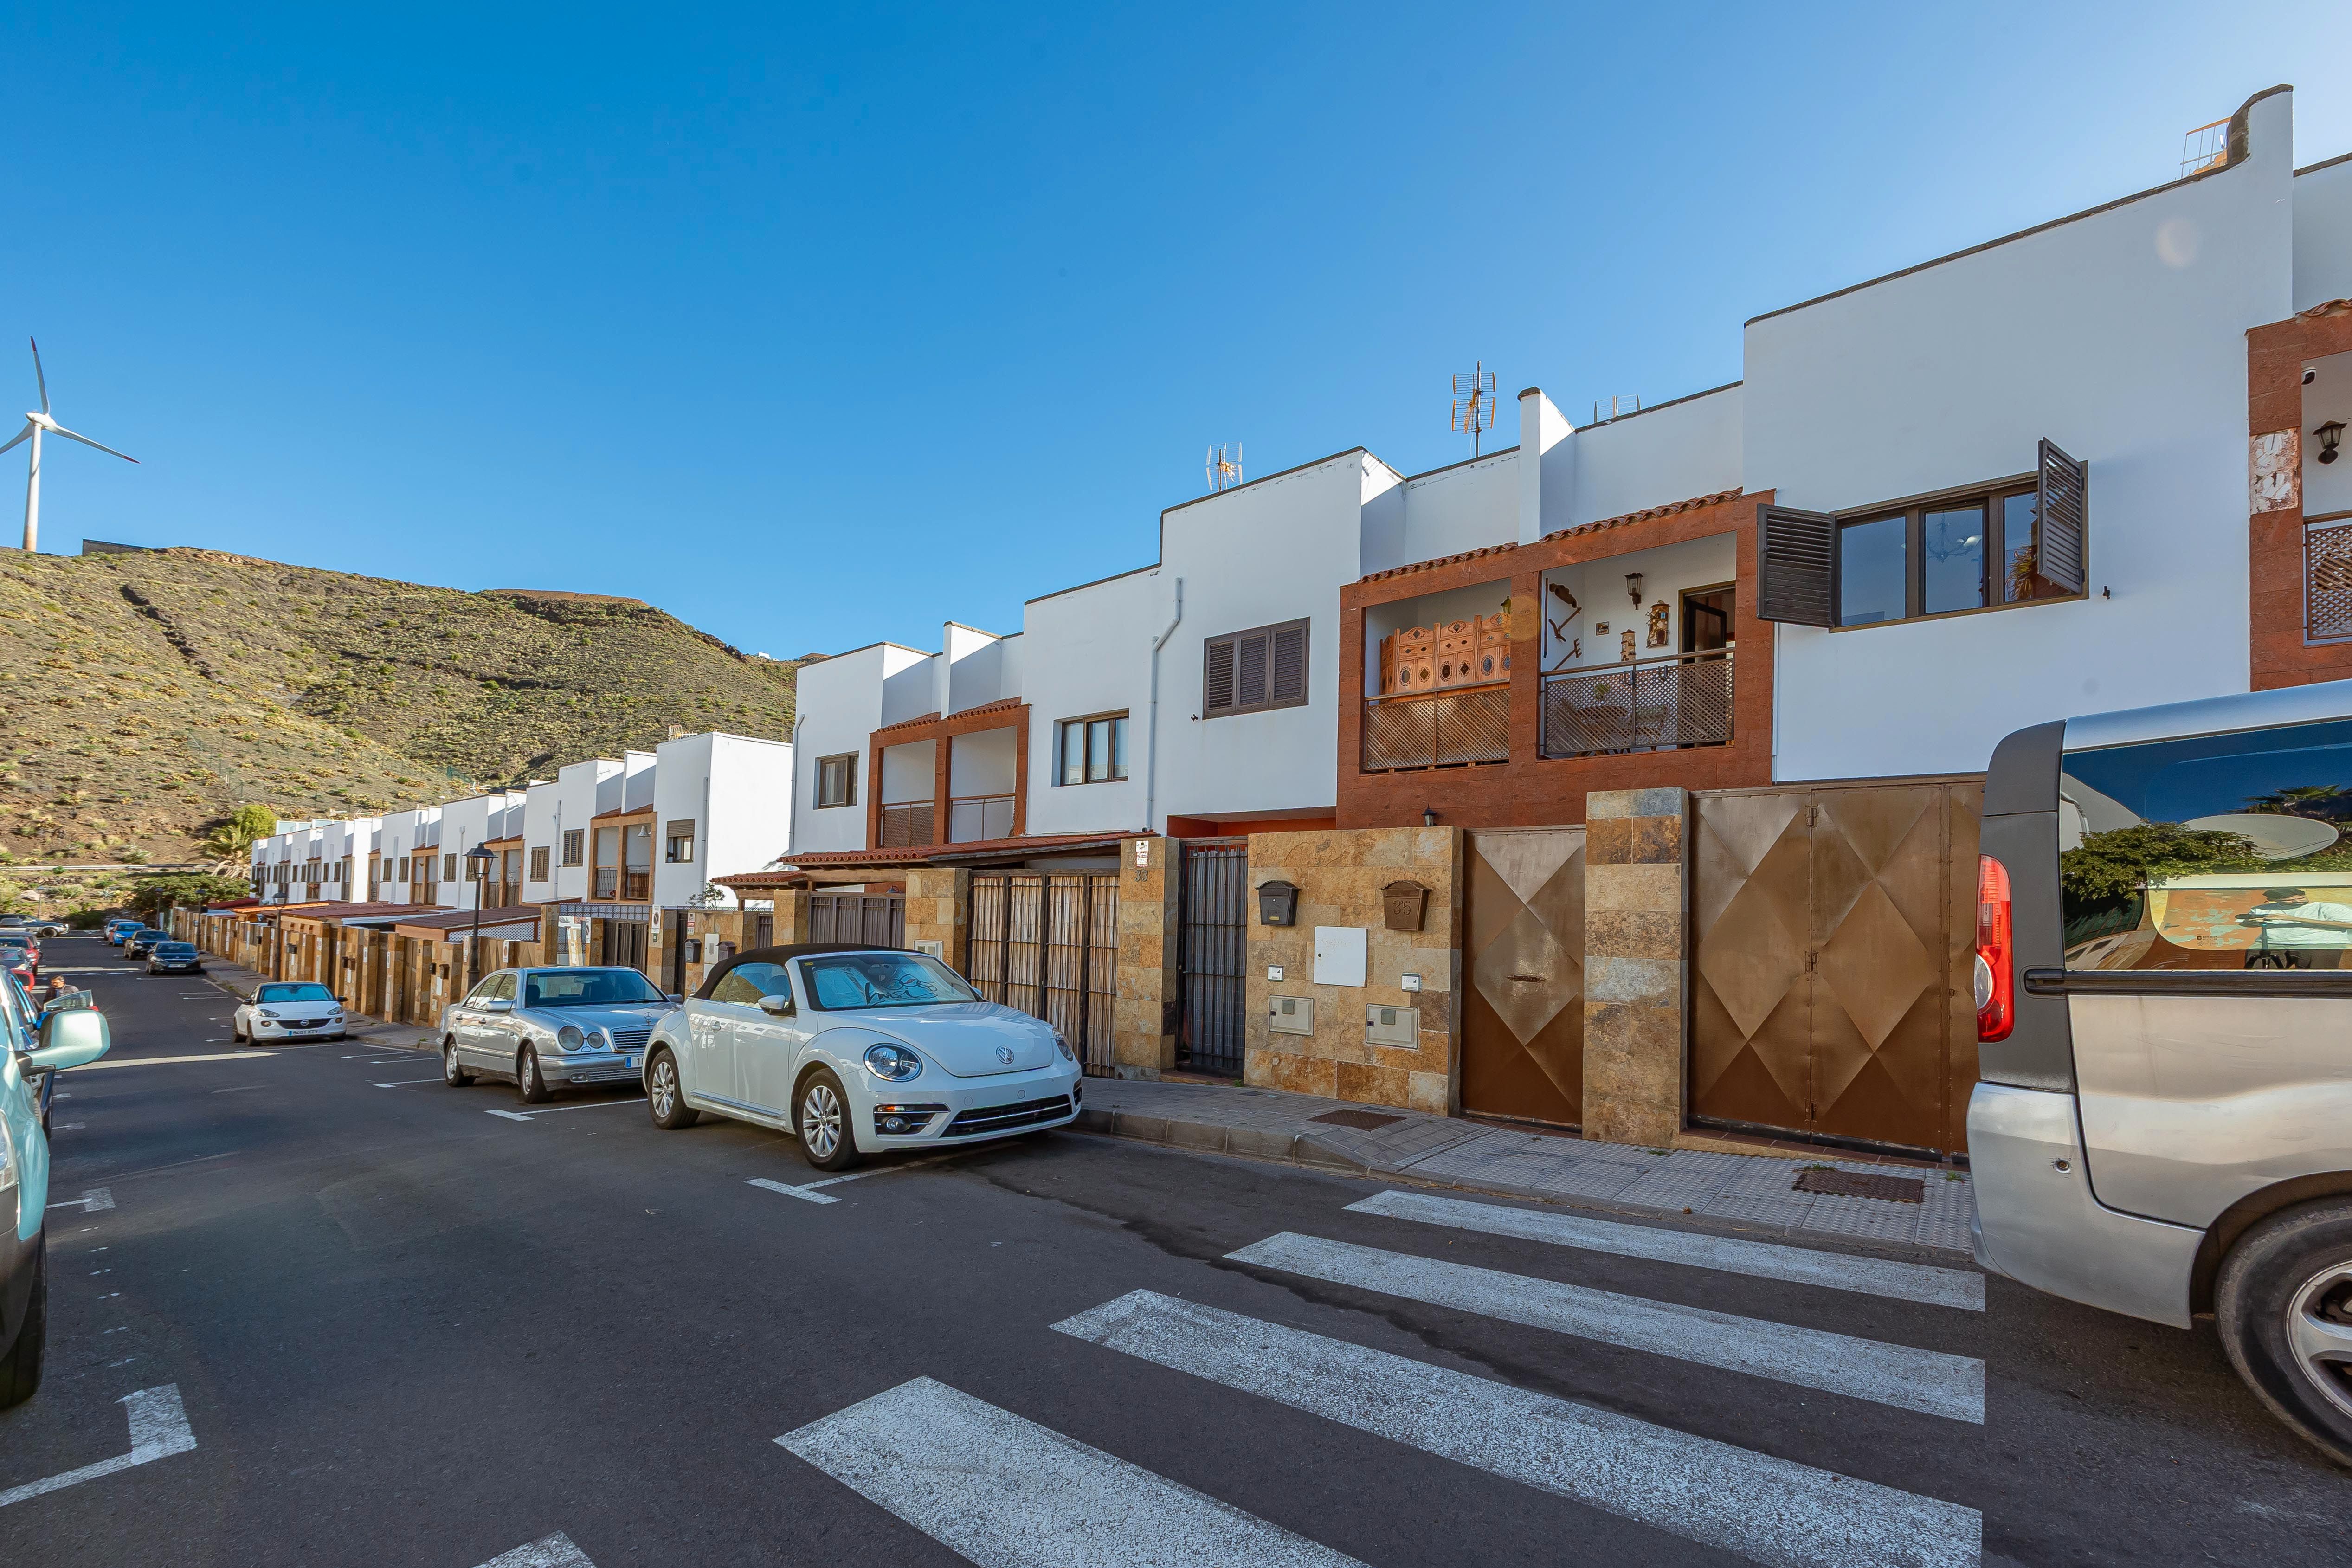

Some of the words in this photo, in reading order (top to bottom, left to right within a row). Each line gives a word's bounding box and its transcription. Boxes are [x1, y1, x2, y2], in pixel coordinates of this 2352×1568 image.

[1134, 870, 1148, 881] 33
[1393, 900, 1411, 916] 35
[996, 1046, 1014, 1064] VW
